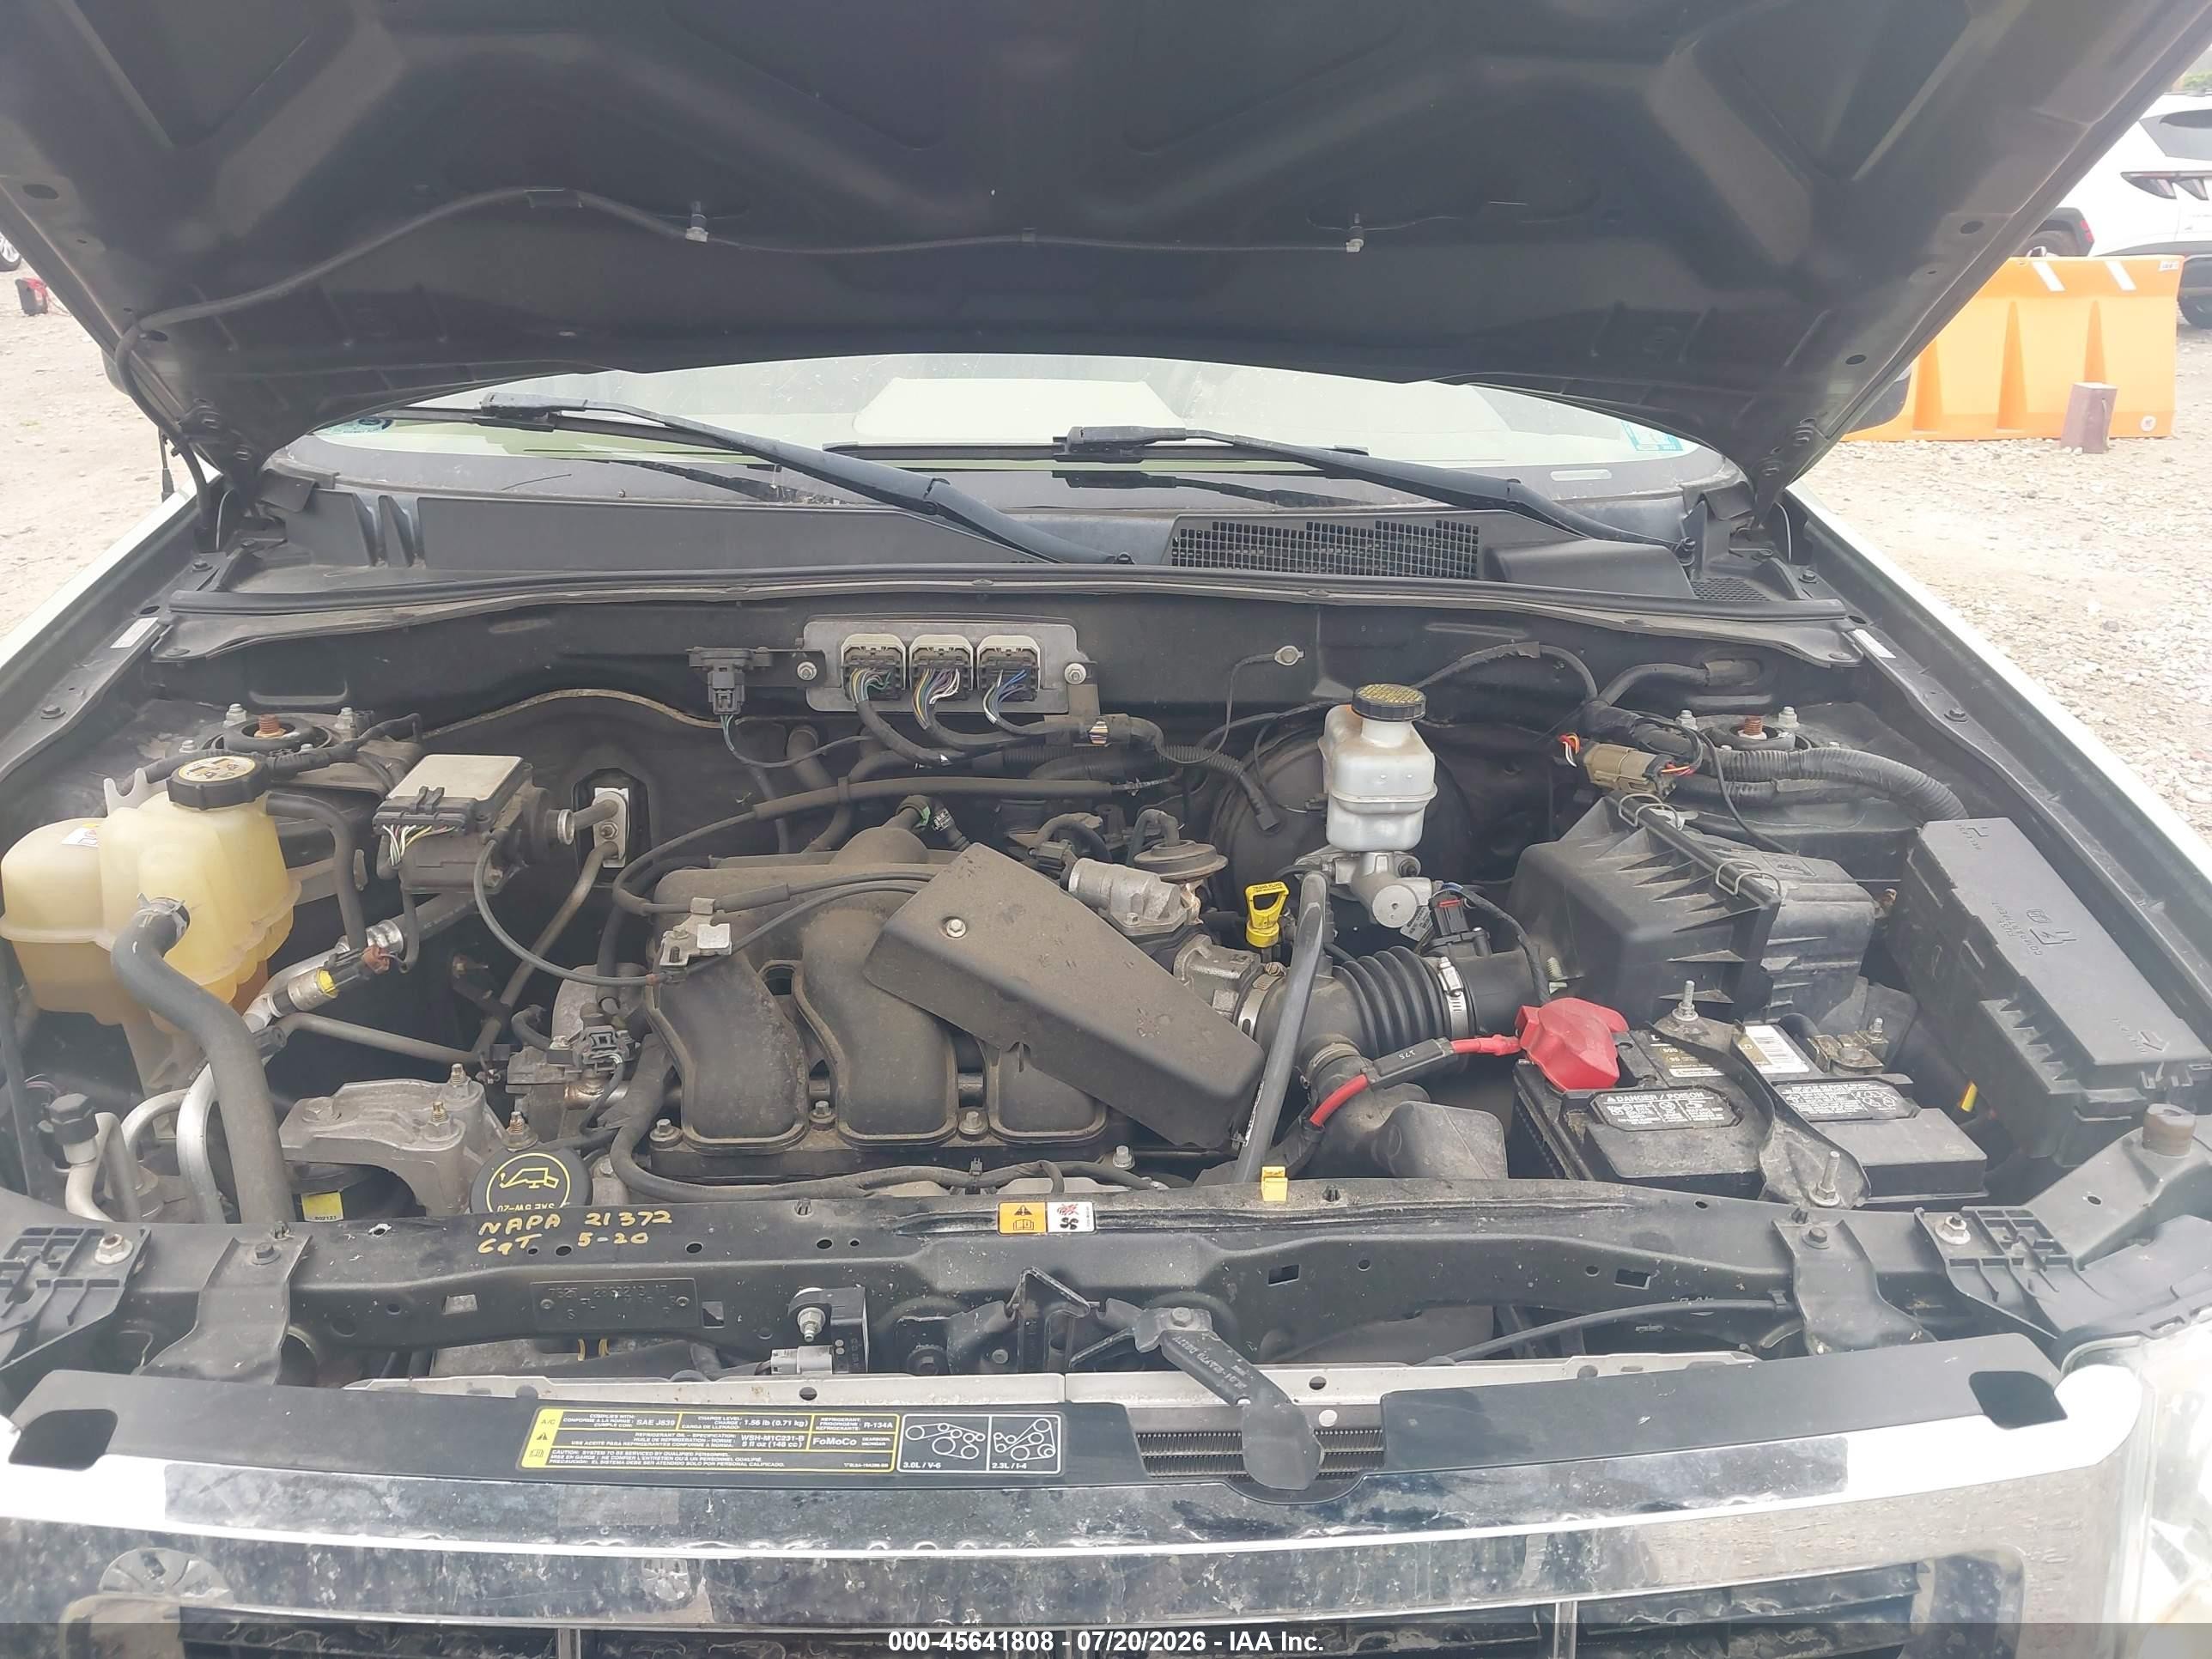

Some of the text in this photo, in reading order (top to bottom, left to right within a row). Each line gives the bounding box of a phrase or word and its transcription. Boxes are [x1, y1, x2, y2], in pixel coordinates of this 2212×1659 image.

[1615, 1094, 1658, 1103] DANGER
[1668, 1091, 1705, 1100] POISON
[478, 1210, 673, 1236] NAPA 21372
[577, 1231, 649, 1248] 5-20
[812, 1437, 858, 1446] FoMoCo
